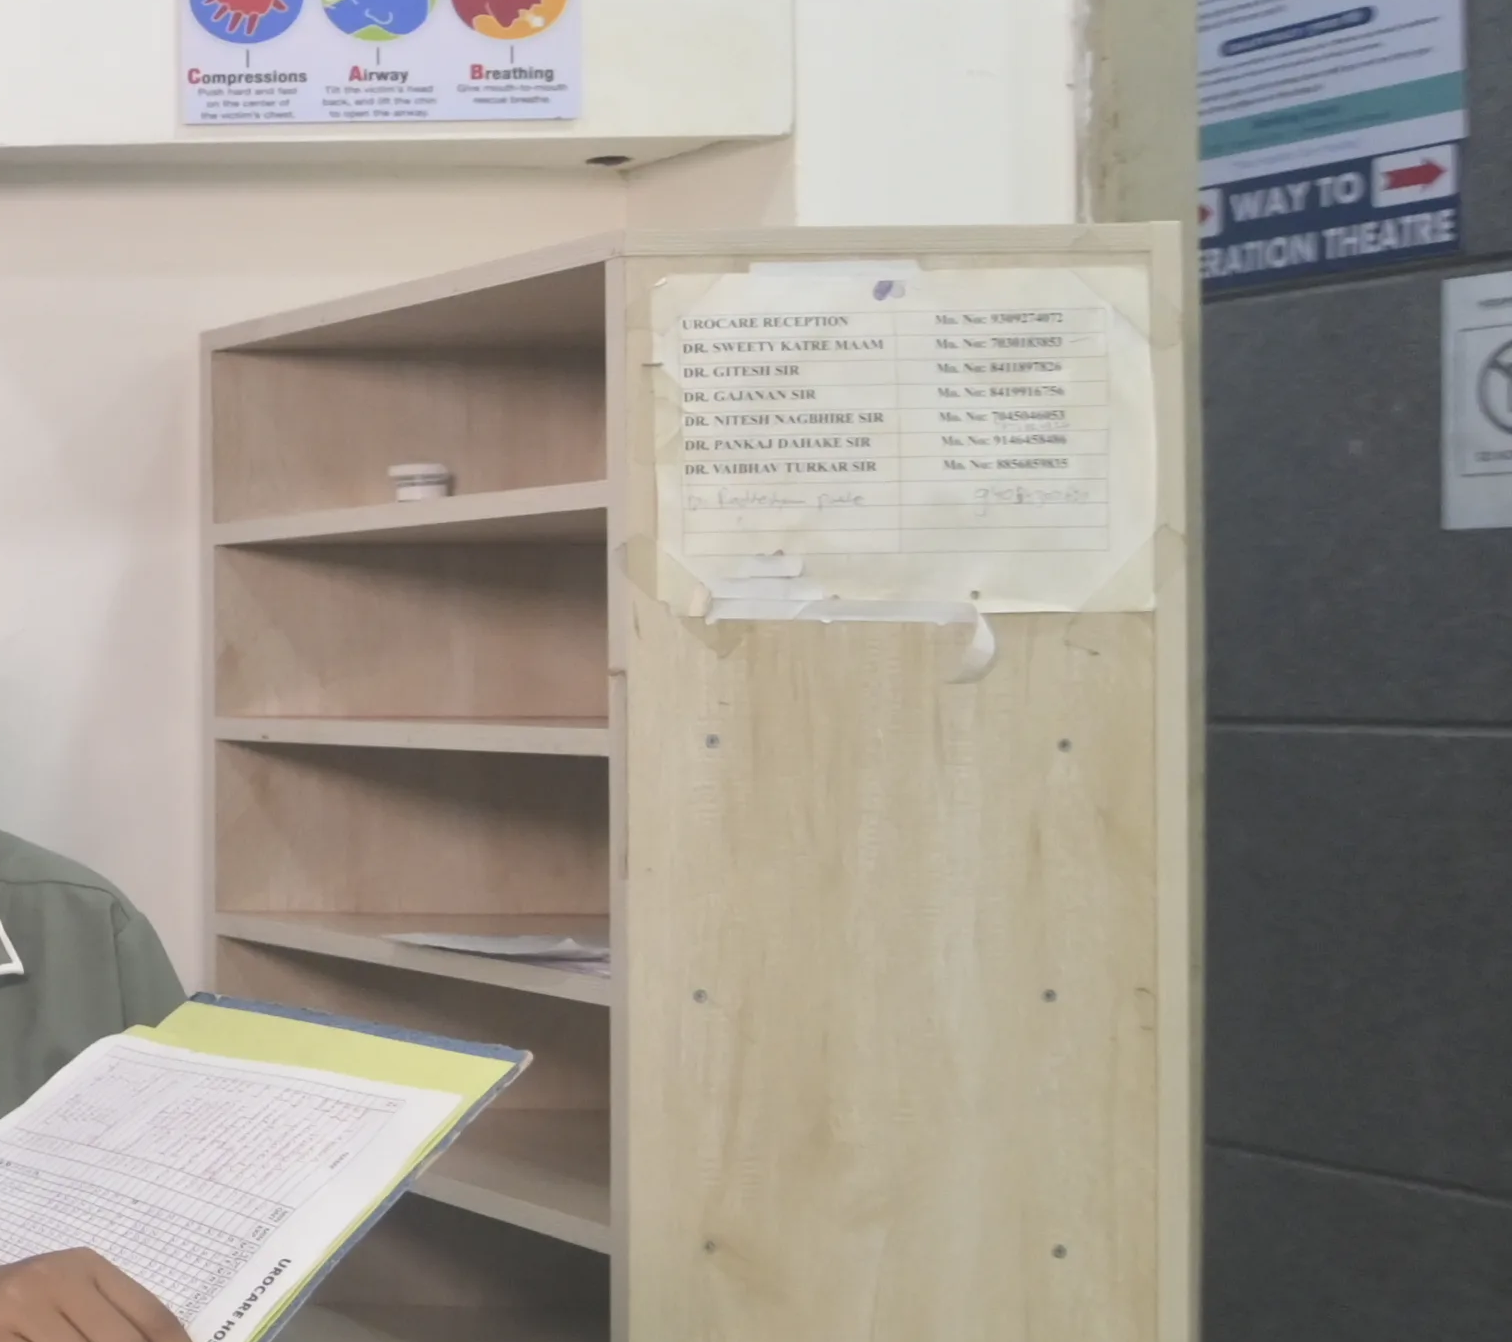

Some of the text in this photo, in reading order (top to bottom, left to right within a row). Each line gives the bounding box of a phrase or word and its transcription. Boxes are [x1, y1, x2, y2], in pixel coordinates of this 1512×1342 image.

[188, 68, 307, 87] Compressions
[349, 65, 408, 84] Airway
[470, 64, 554, 82] Breathing
[1230, 172, 1363, 222] WAY TO
[1200, 209, 1456, 277] RATION THEATRE
[682, 316, 849, 330] UROCARE RECEPTION
[683, 340, 883, 354] DR. SWEETY KATRE MAAM
[684, 365, 799, 378] DR. GITESH SIR
[684, 390, 816, 402] DR. GAJANAN SIR
[685, 412, 883, 426] DR. NITESH NAGBHIRE SIR
[685, 437, 871, 451] DR. PANKAJ DAHAKE SIR
[685, 461, 877, 475] DR. VAIBHAV TURKAR SIR
[232, 1258, 292, 1319] UROCARE
